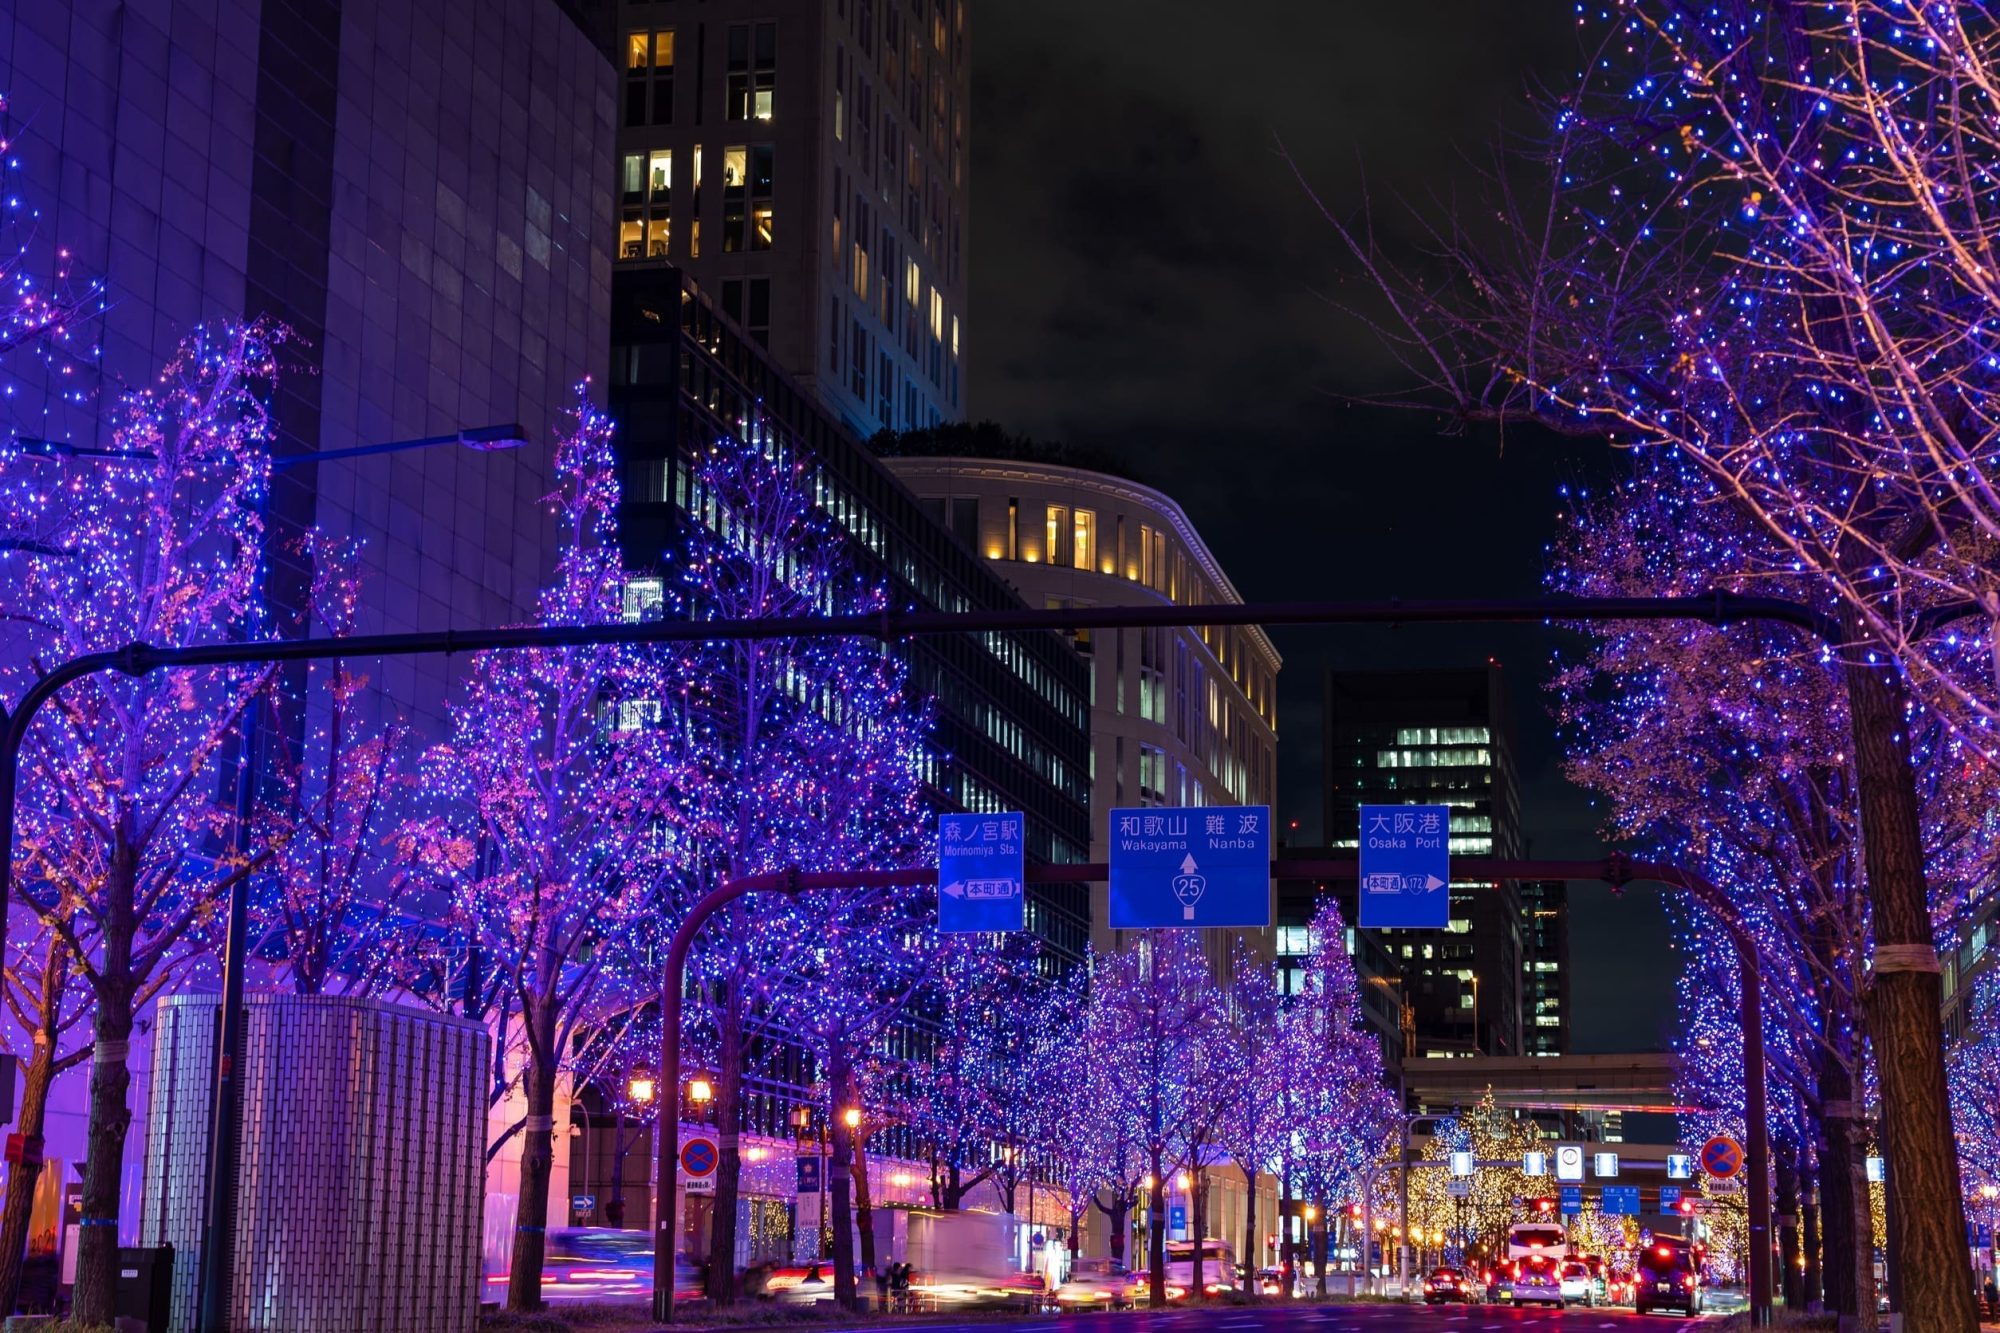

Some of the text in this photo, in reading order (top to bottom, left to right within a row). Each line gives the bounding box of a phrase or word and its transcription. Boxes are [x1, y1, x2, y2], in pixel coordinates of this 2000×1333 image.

[1120, 815, 1187, 836] 和歌山
[1369, 813, 1440, 834] 大阪港
[944, 820, 1018, 842] 森ノ宮駅
[1121, 838, 1255, 852] Wakayama Nanba
[1369, 837, 1440, 849] Osaka Port
[944, 843, 1018, 858] Morinomiya Sta.
[969, 882, 1010, 896] 本町通
[1178, 878, 1200, 897] 25
[1370, 876, 1400, 890] 本町通
[1409, 877, 1423, 889] 172
